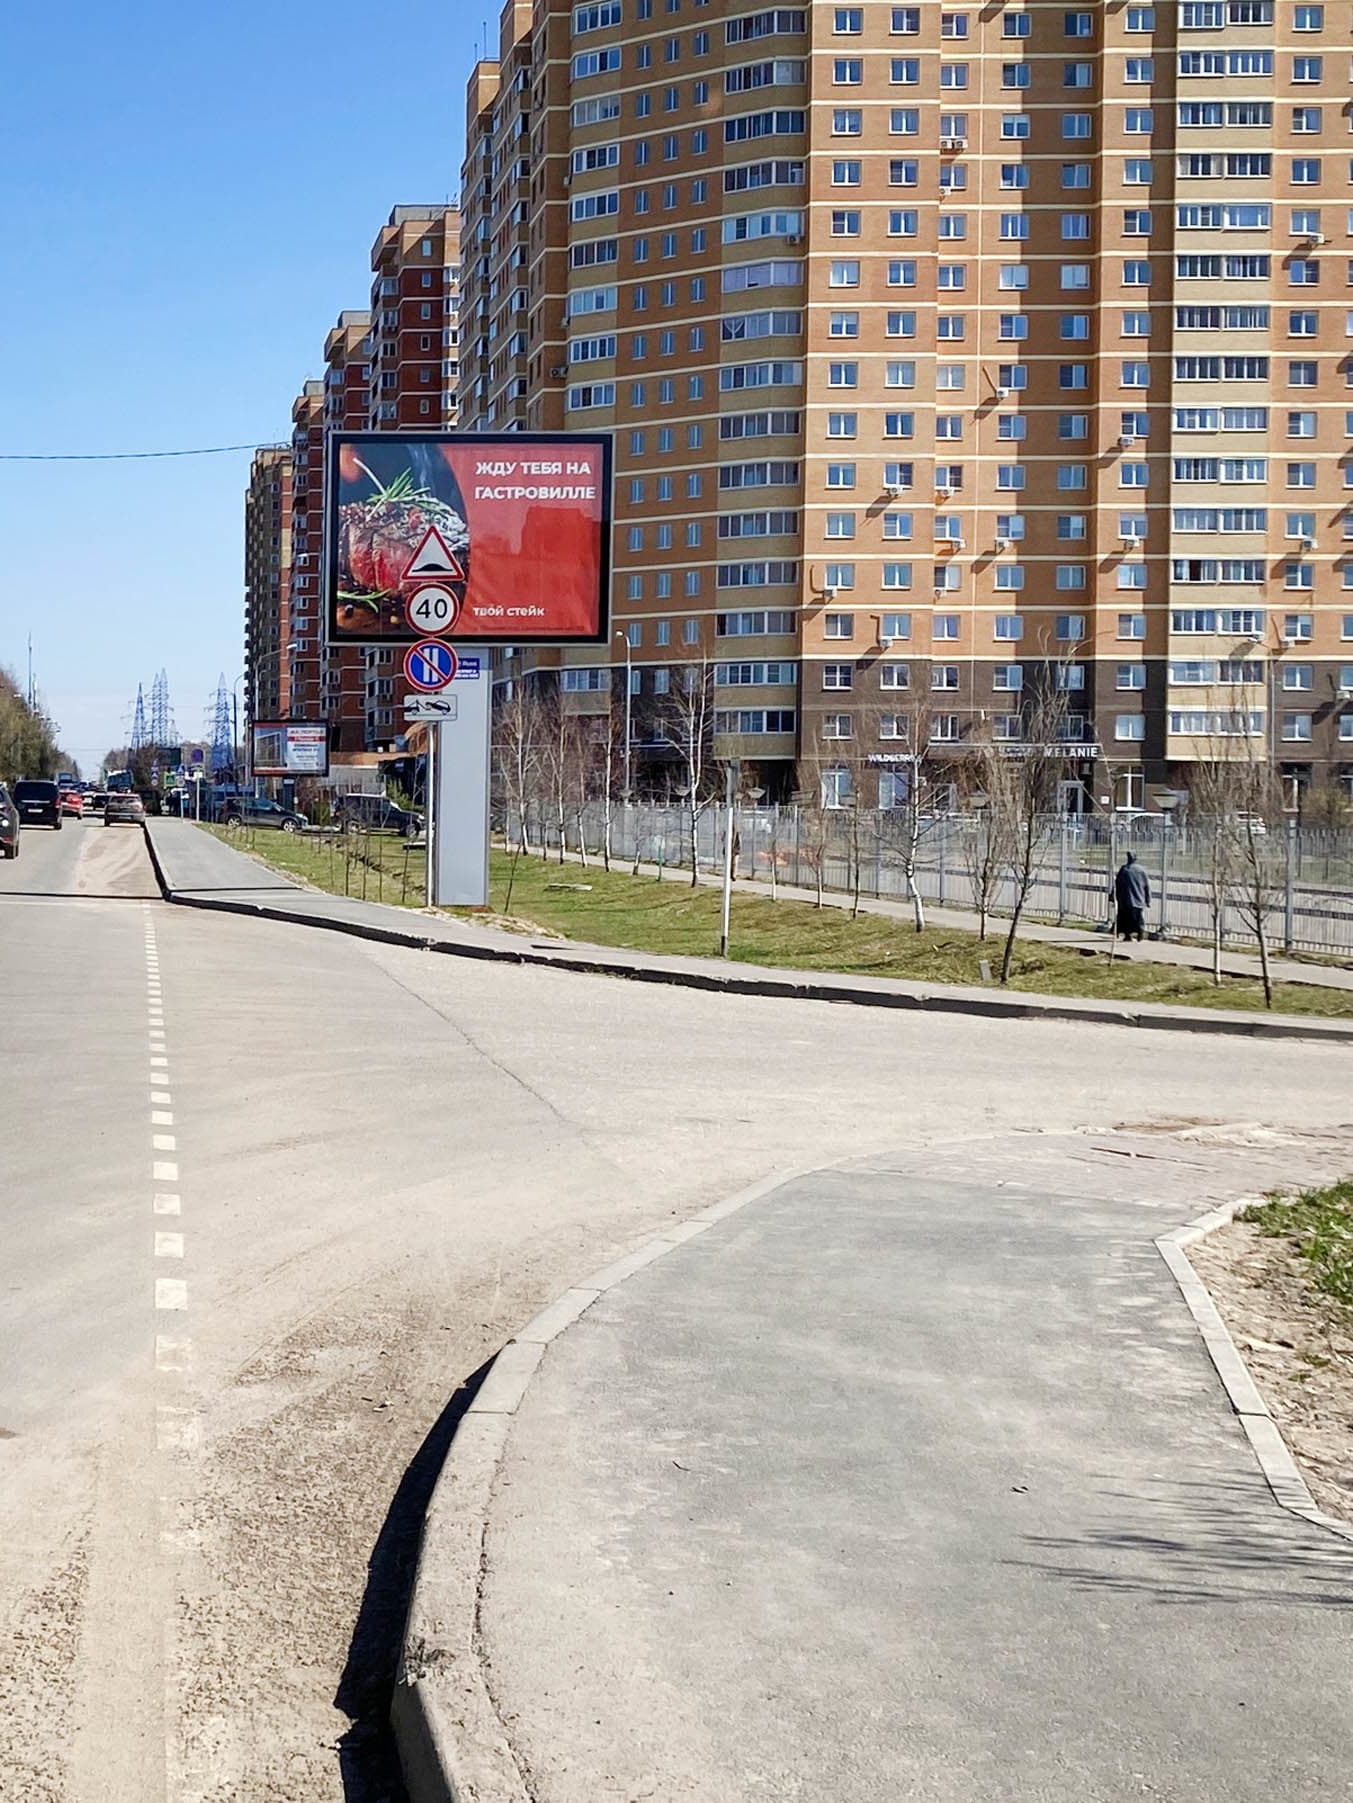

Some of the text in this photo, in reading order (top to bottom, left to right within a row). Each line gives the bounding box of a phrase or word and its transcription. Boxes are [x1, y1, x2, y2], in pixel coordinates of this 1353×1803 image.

[475, 461, 591, 476] ЖДУ ТЕБЯ НА
[474, 486, 597, 499] ГАСТРОВИЛЛЕ
[415, 598, 448, 619] 40
[472, 604, 545, 617] твой стейк
